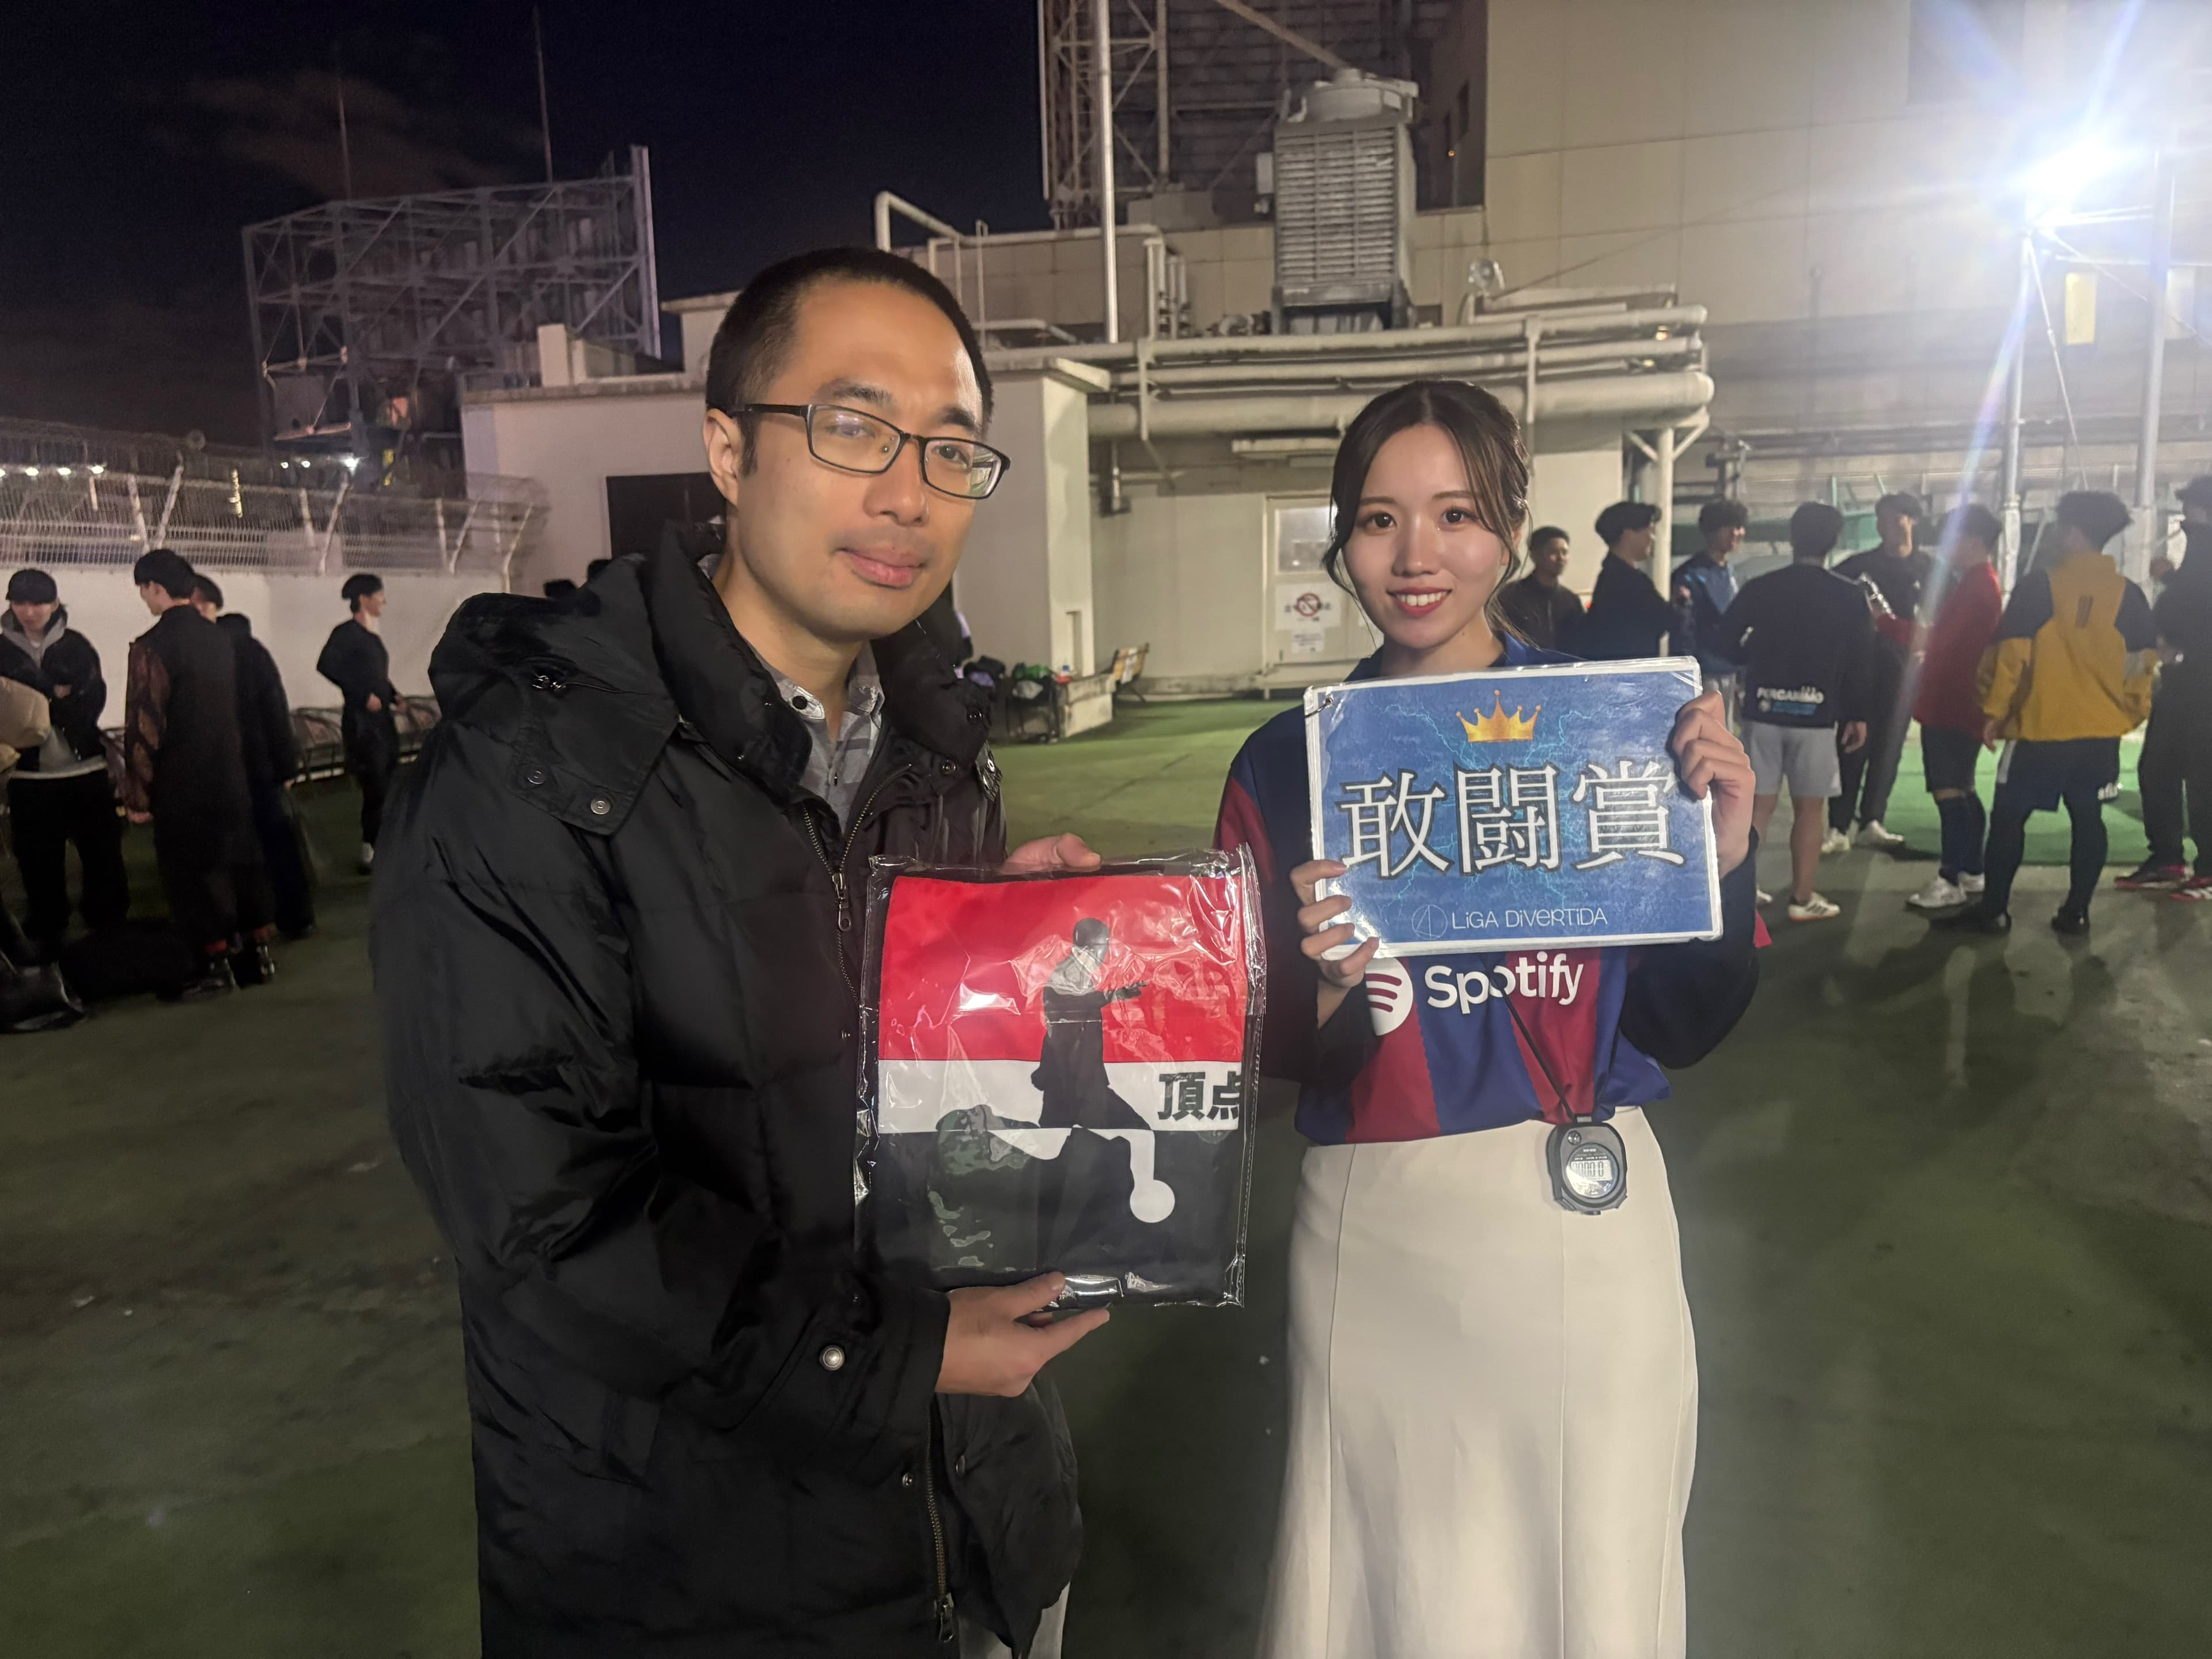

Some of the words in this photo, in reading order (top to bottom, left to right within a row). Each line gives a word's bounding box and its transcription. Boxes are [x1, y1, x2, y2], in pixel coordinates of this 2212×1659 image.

[1338, 758, 1686, 878] 敢闘賞
[1424, 950, 1584, 1014] Spotify
[1157, 1070, 1241, 1122] 頂点
